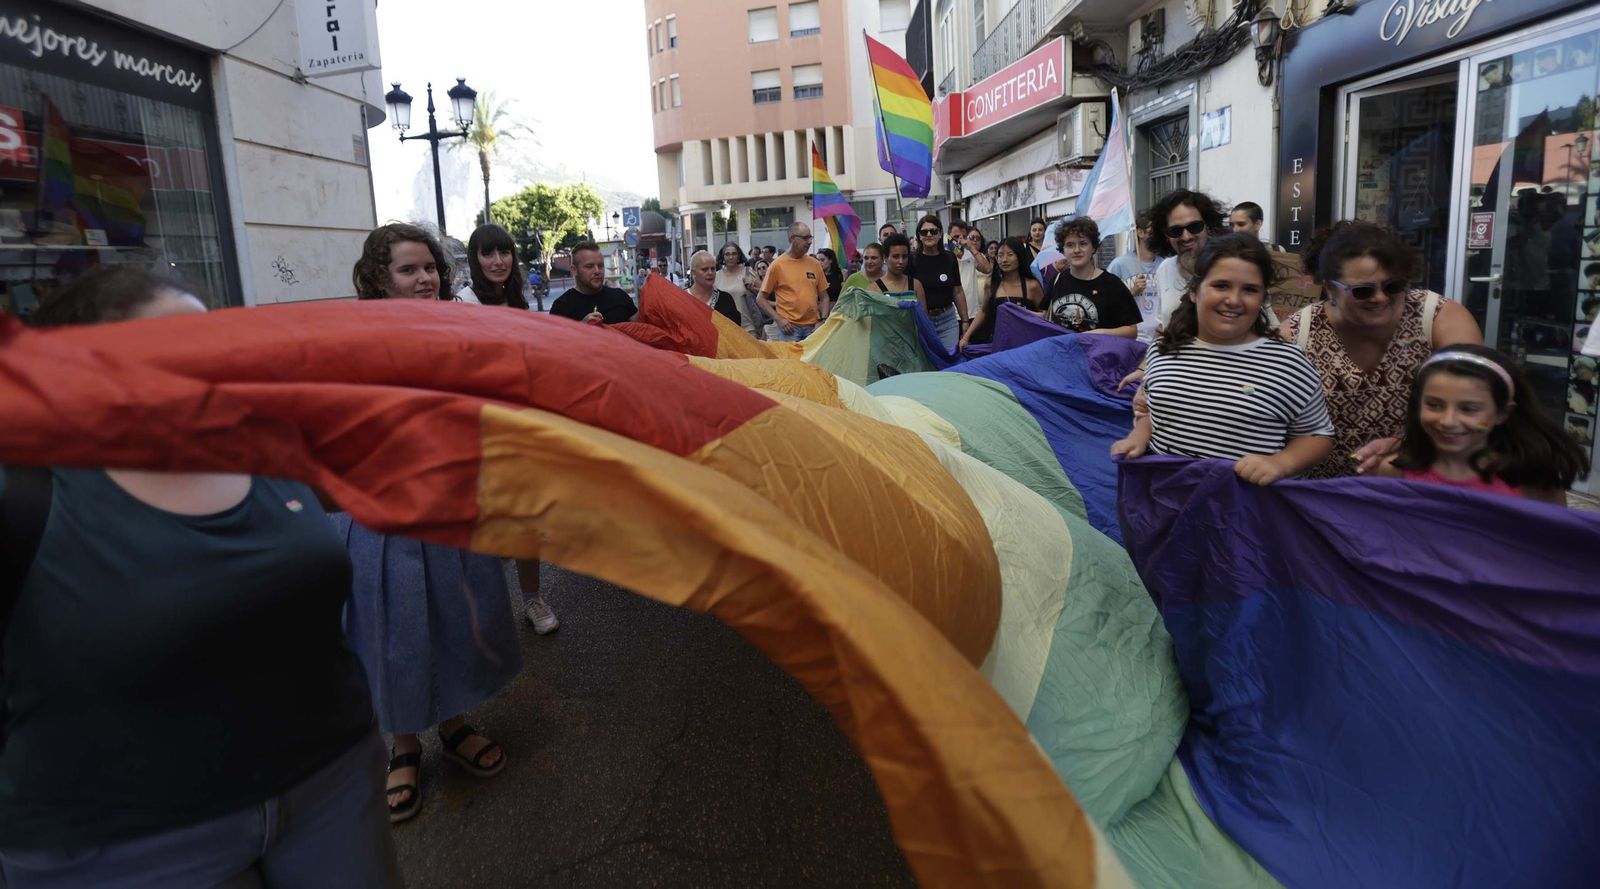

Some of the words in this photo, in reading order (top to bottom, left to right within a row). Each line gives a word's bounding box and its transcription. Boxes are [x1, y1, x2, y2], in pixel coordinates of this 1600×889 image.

[326, 0, 340, 51] ral
[1380, 0, 1491, 46] Visag
[113, 50, 202, 93] marcas
[966, 57, 1058, 123] CONFITERIA
